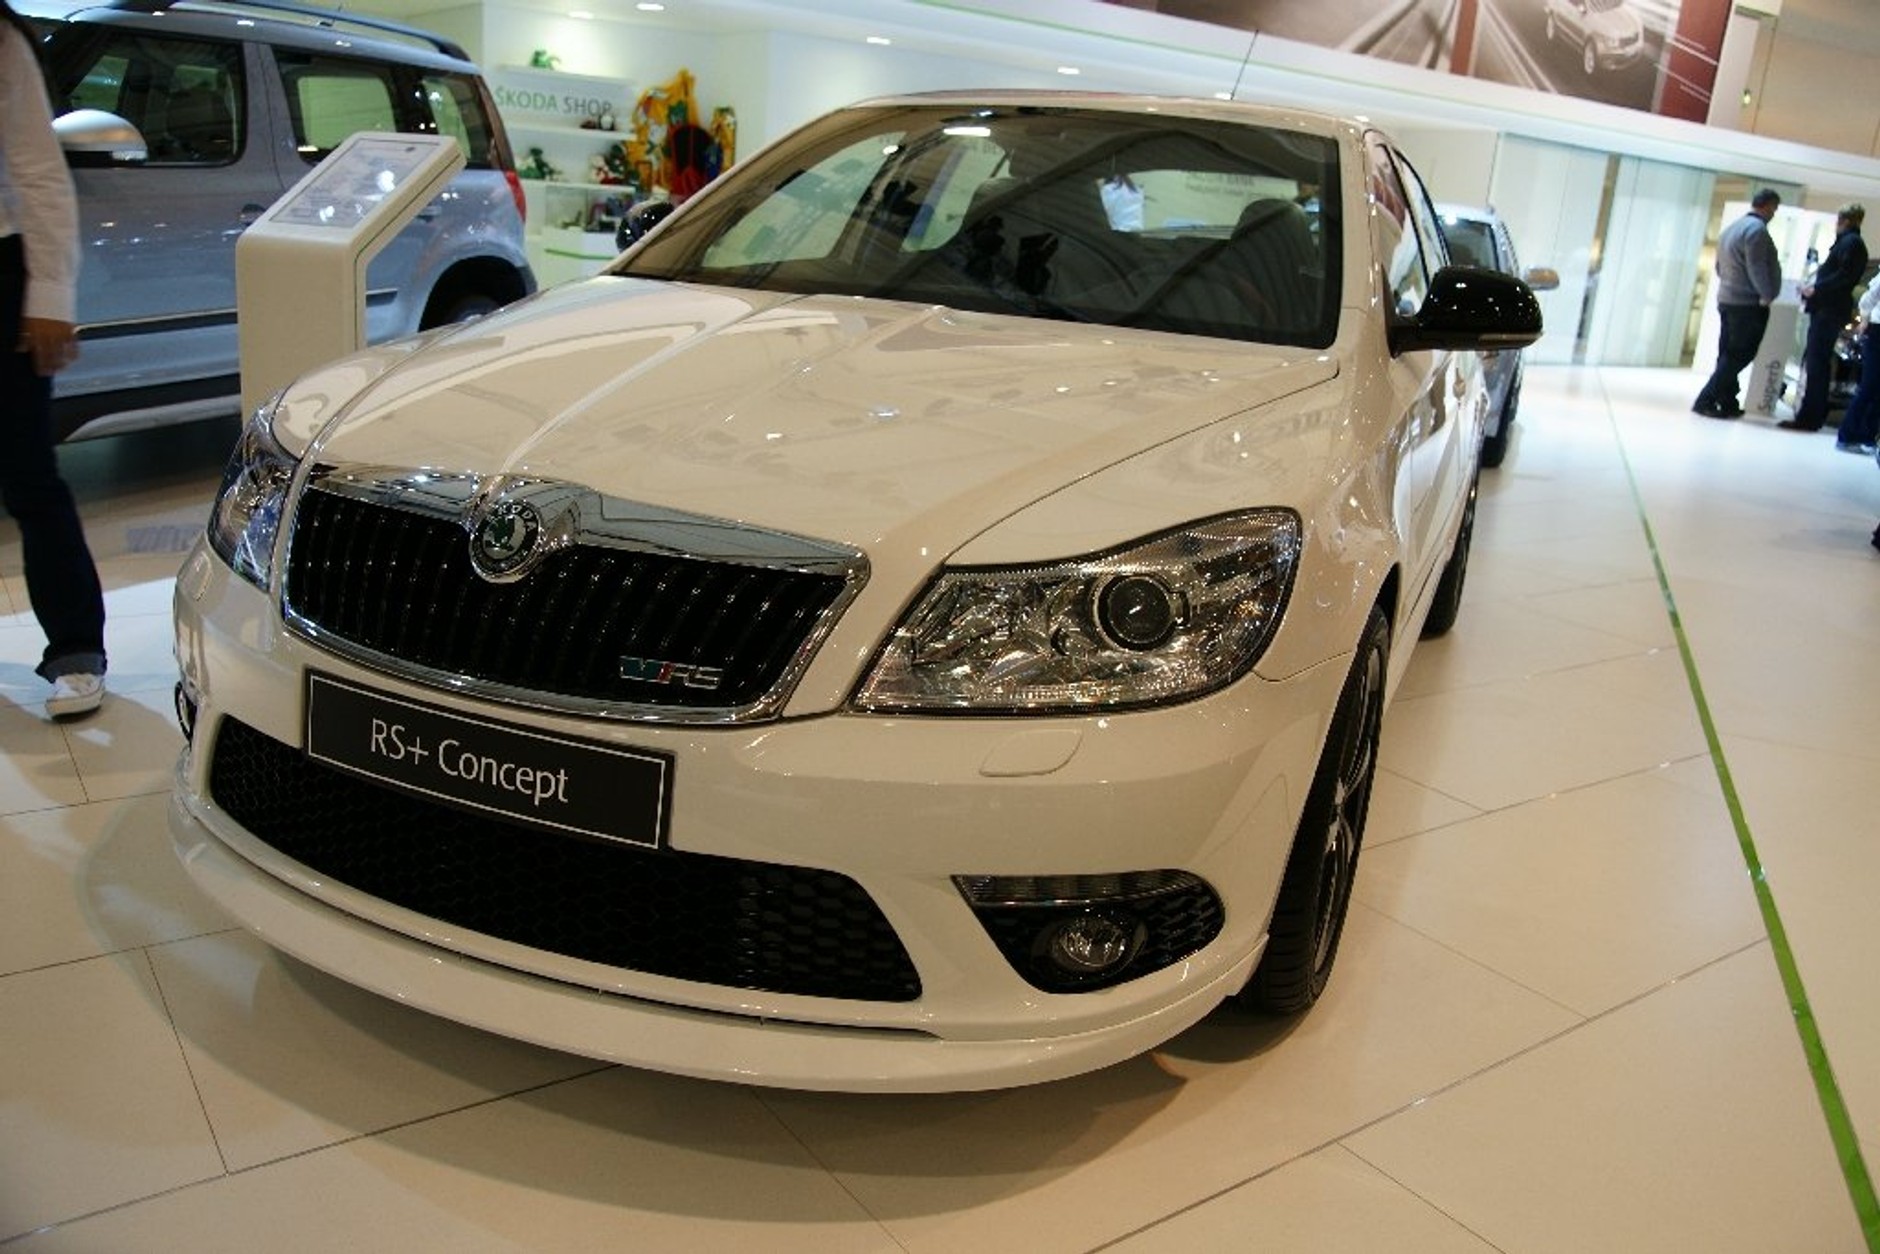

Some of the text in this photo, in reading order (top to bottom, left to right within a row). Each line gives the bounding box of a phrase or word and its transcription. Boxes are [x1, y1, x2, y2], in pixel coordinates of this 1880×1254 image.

[562, 95, 613, 118] SHOP
[370, 717, 569, 806] RS+ Concept
